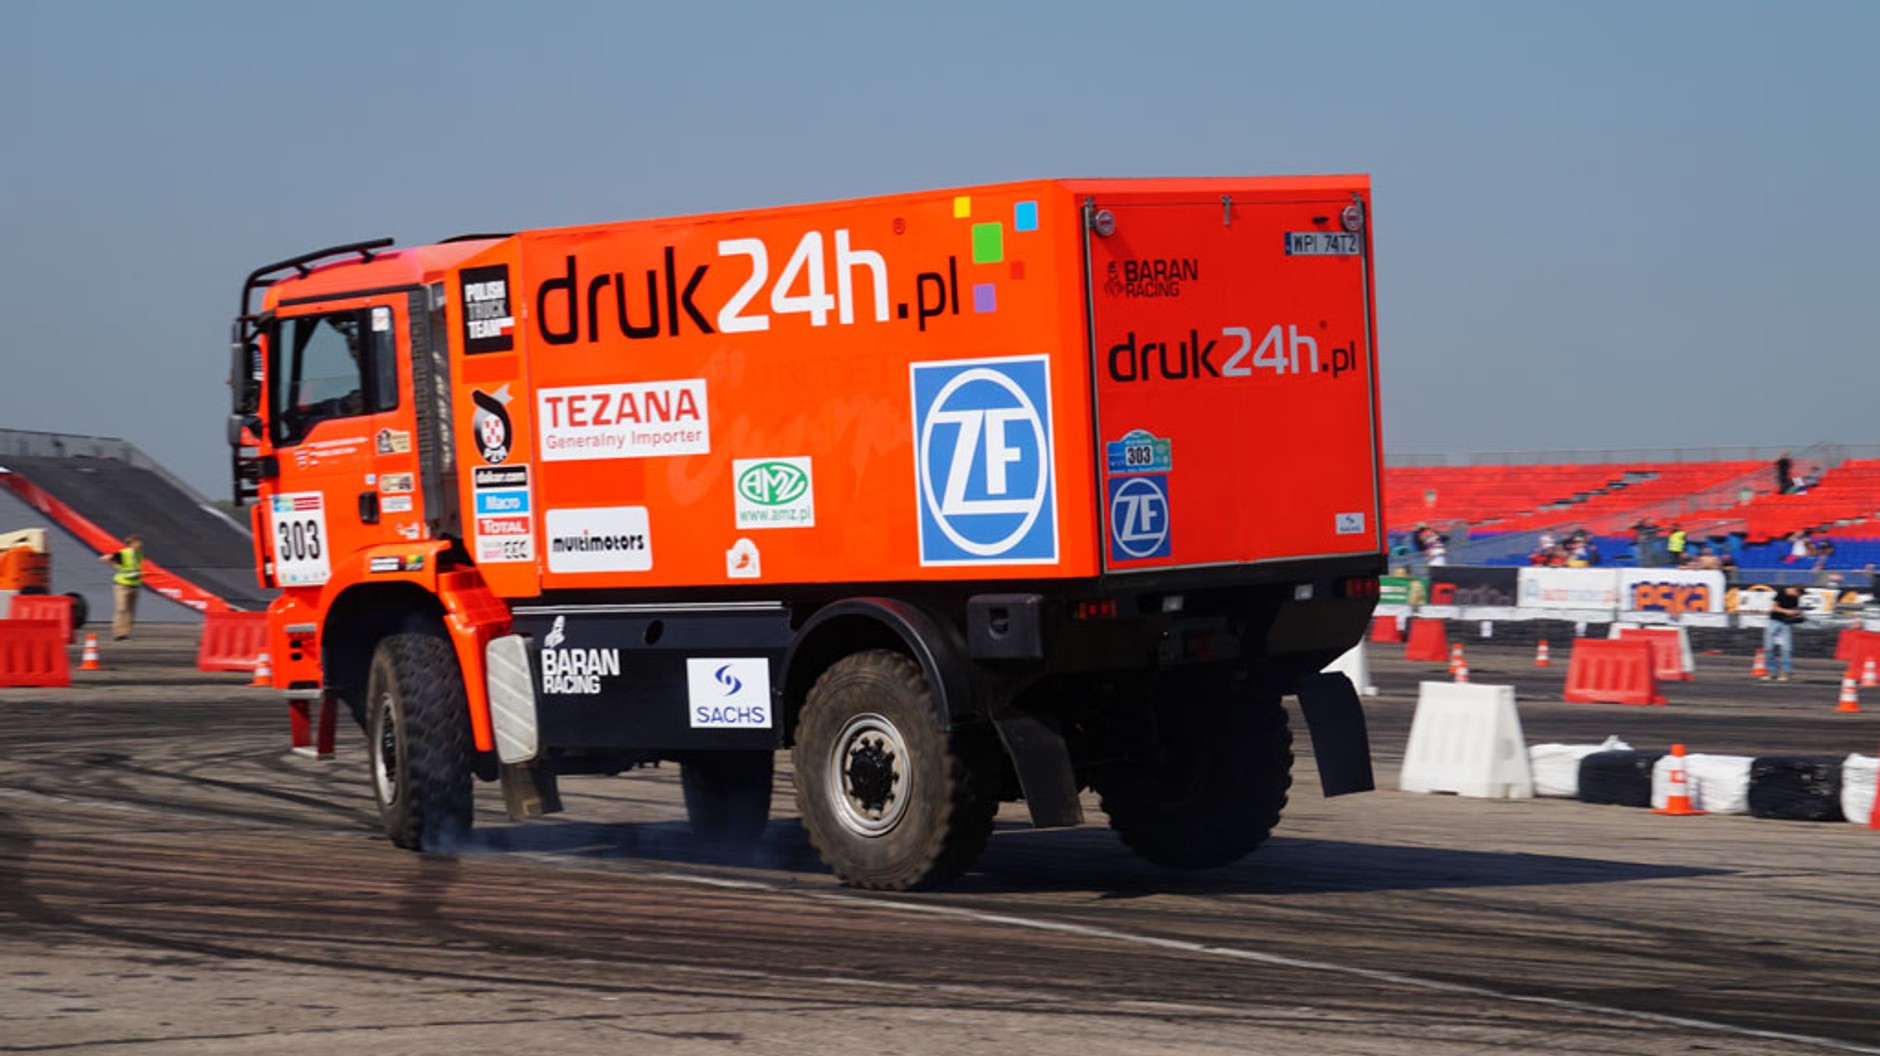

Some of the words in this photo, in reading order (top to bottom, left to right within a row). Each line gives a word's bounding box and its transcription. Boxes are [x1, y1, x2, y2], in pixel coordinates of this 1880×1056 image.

[1293, 235, 1318, 253] WPI
[1125, 259, 1199, 283] BARAN
[537, 229, 959, 345] druk24h.pl
[1125, 281, 1180, 298] RACING
[1108, 325, 1356, 382] druk24h.pl
[545, 388, 700, 428] TEZANA
[546, 432, 626, 450] Generalny
[631, 429, 703, 447] Importer
[932, 407, 1036, 516] ZF
[1127, 446, 1152, 465] 303
[741, 466, 806, 503] AMZ
[739, 505, 812, 524] www.amz.pl
[1116, 494, 1163, 541] ZF
[279, 519, 321, 562] 303
[553, 529, 645, 552] multimotors
[541, 648, 620, 676] BARAN
[543, 675, 601, 694] RACING
[696, 706, 766, 724] SACHS
